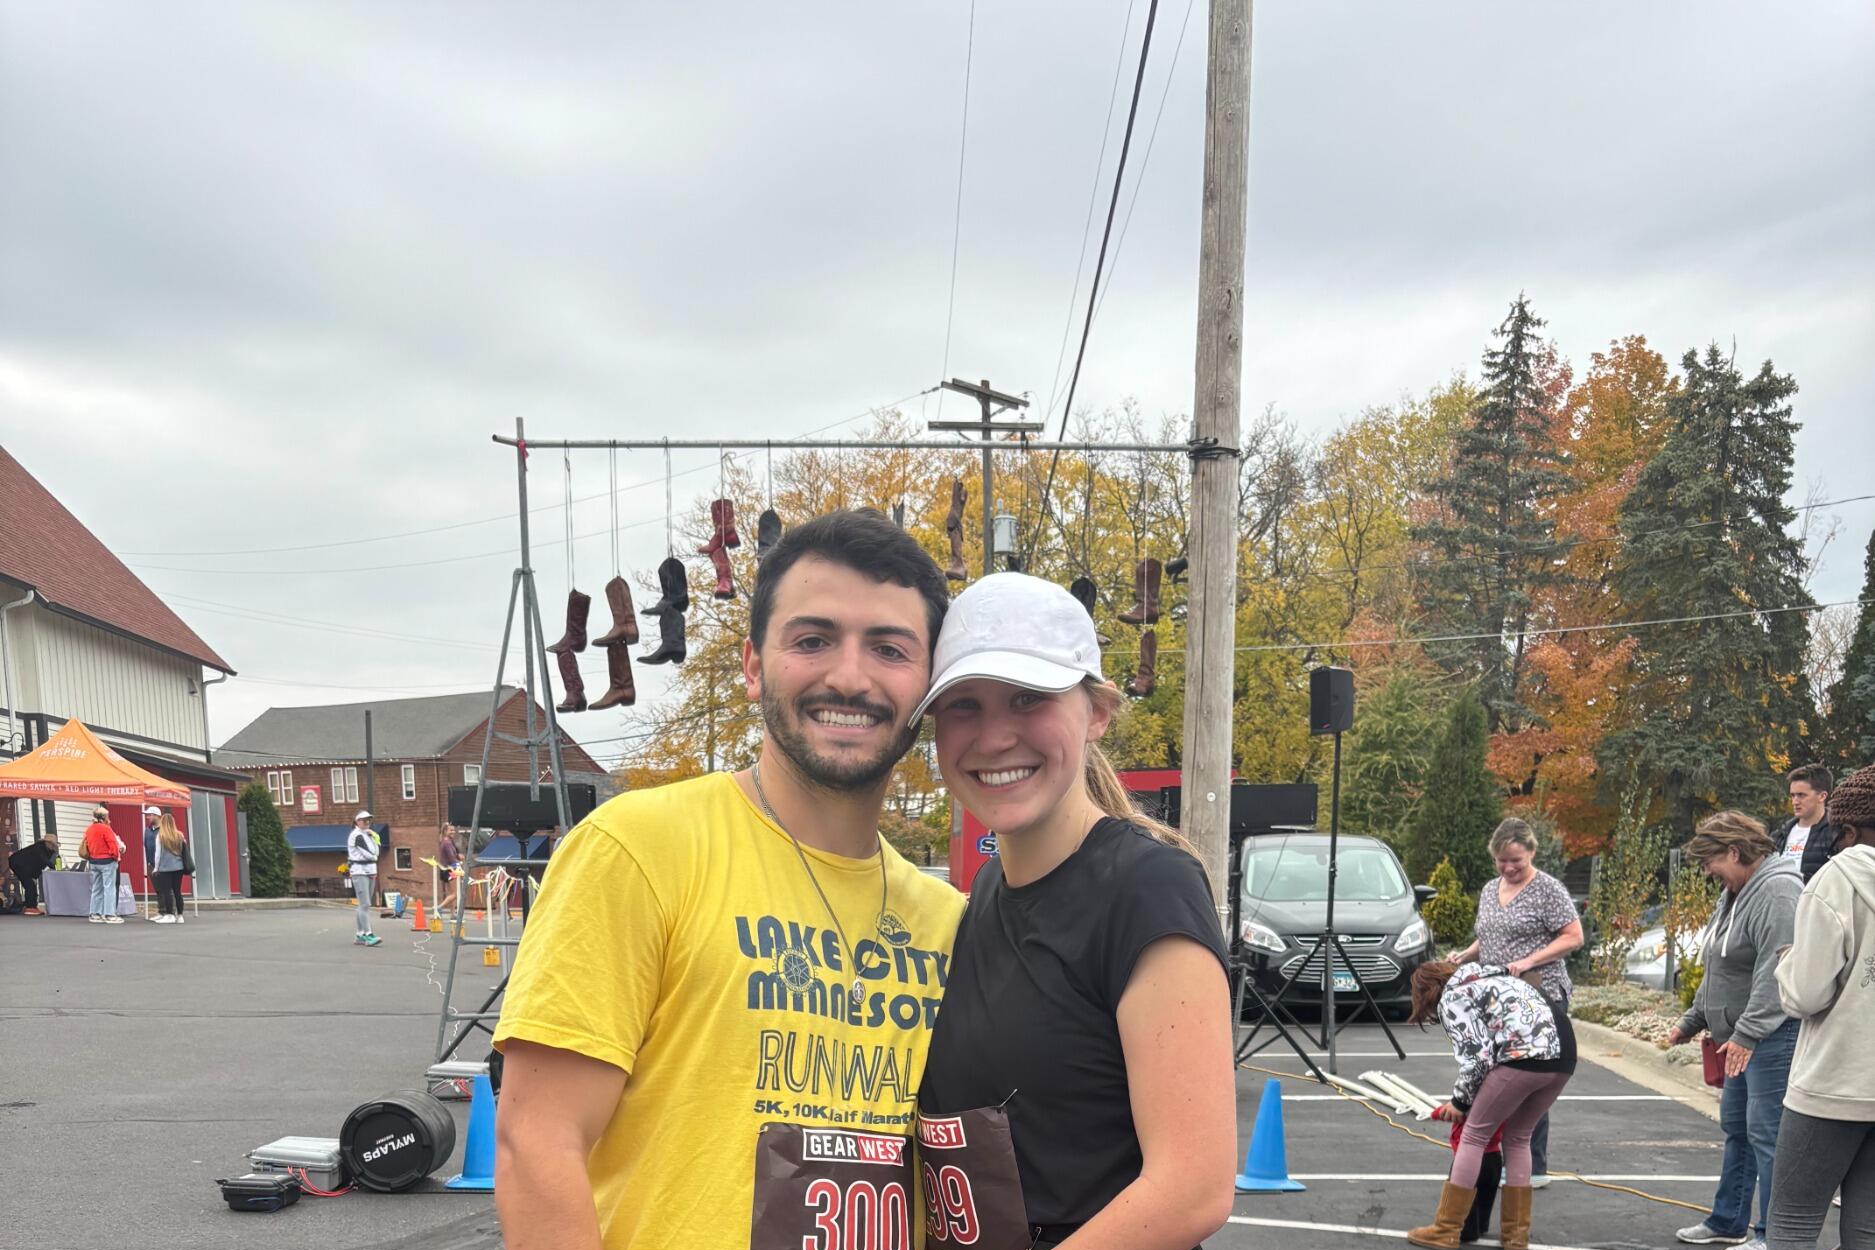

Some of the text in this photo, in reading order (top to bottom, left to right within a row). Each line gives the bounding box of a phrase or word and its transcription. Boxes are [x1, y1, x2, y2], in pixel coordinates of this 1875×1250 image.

[82, 786, 104, 794] LIGHT
[735, 914, 843, 972] LAKE
[854, 938, 950, 989] CITY
[753, 1099, 790, 1118] 5K,
[362, 1132, 416, 1163] MYLAPS
[810, 1134, 906, 1162] GEAR WEST
